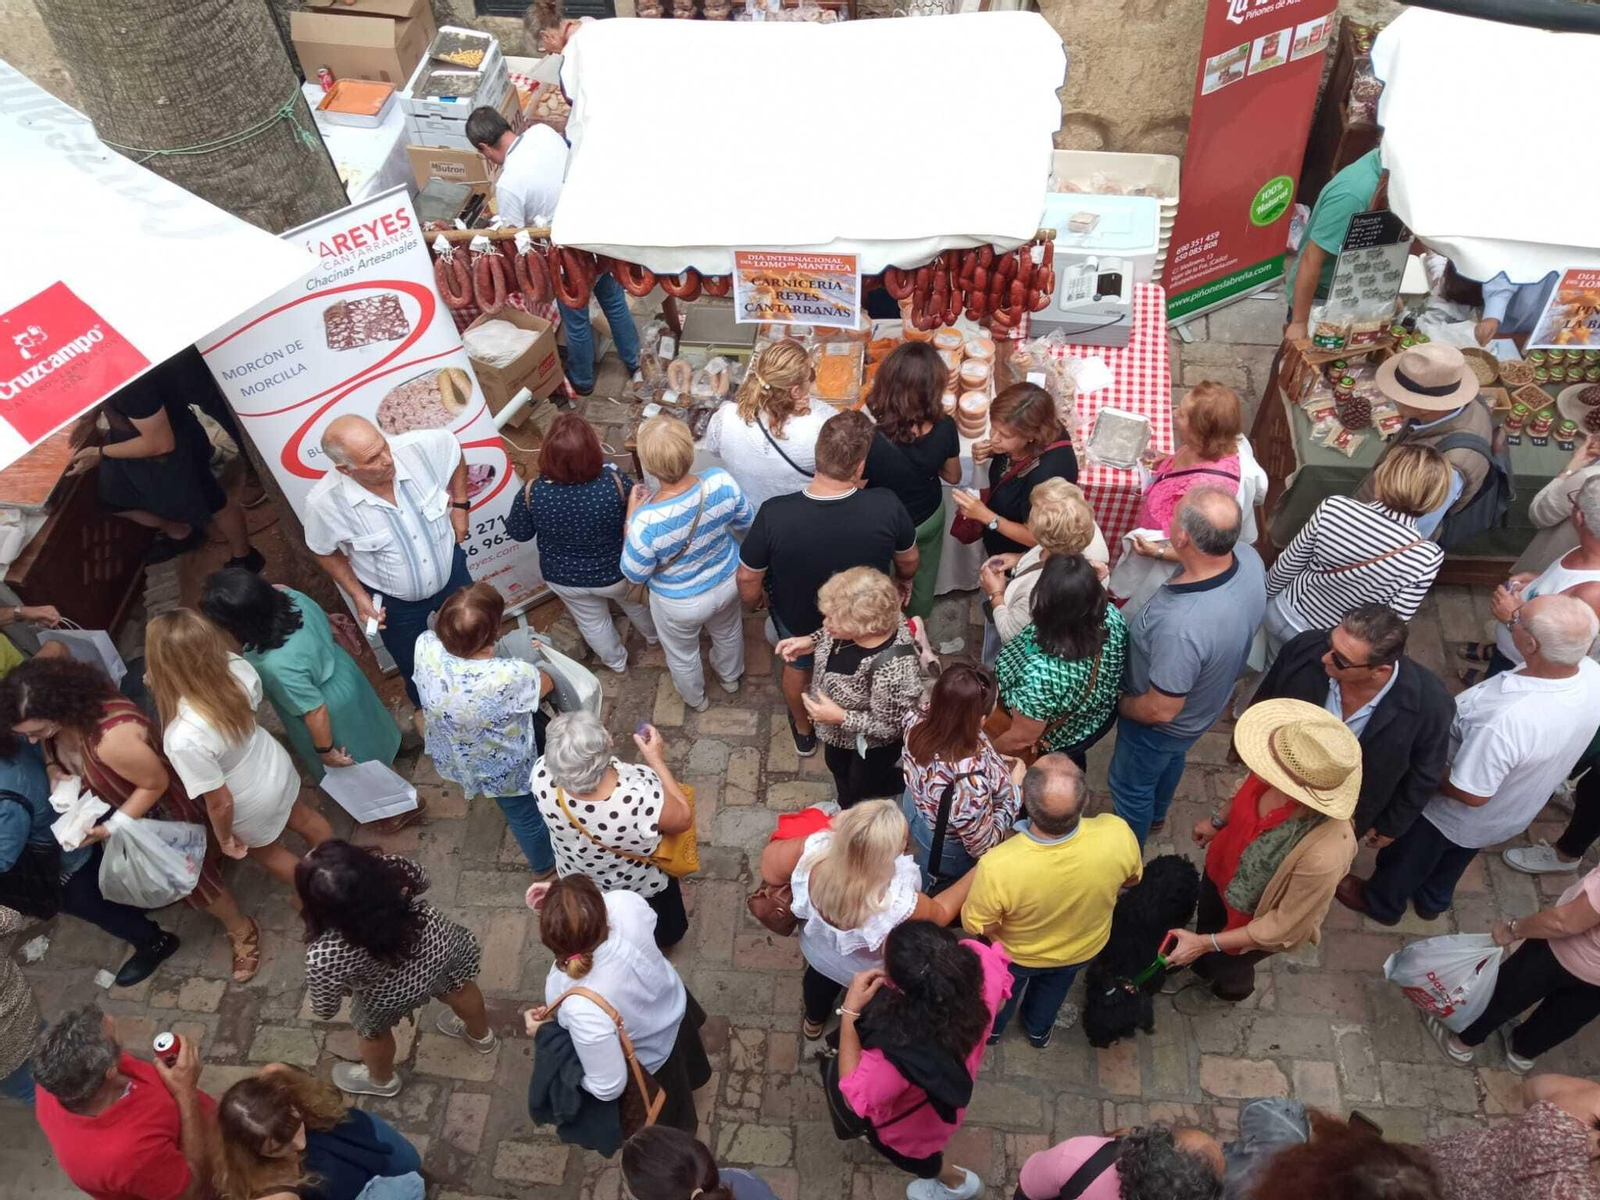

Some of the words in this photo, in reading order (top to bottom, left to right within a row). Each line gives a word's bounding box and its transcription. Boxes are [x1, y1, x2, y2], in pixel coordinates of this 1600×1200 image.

[1245, 5, 1275, 20] Piñones
[1261, 182, 1284, 202] 100%
[1256, 188, 1289, 214] Natural
[323, 229, 413, 271] CANTARRANAS
[306, 265, 355, 291] Chacinas
[357, 238, 418, 271] Artesanales
[767, 255, 843, 266] INTERNACIONAL
[797, 262, 852, 273] MANTECA
[751, 277, 843, 291] CARNICERÍA
[1577, 273, 1596, 281] DIA
[776, 291, 820, 302] REYES
[744, 302, 851, 317] CANTARRANAS
[1563, 320, 1583, 329] LA
[0, 328, 104, 400] Cruzcampo
[222, 350, 285, 381] MORCÓN
[285, 340, 305, 356] DE
[240, 363, 308, 398] MORCILLA
[469, 543, 520, 572] eyes.com
